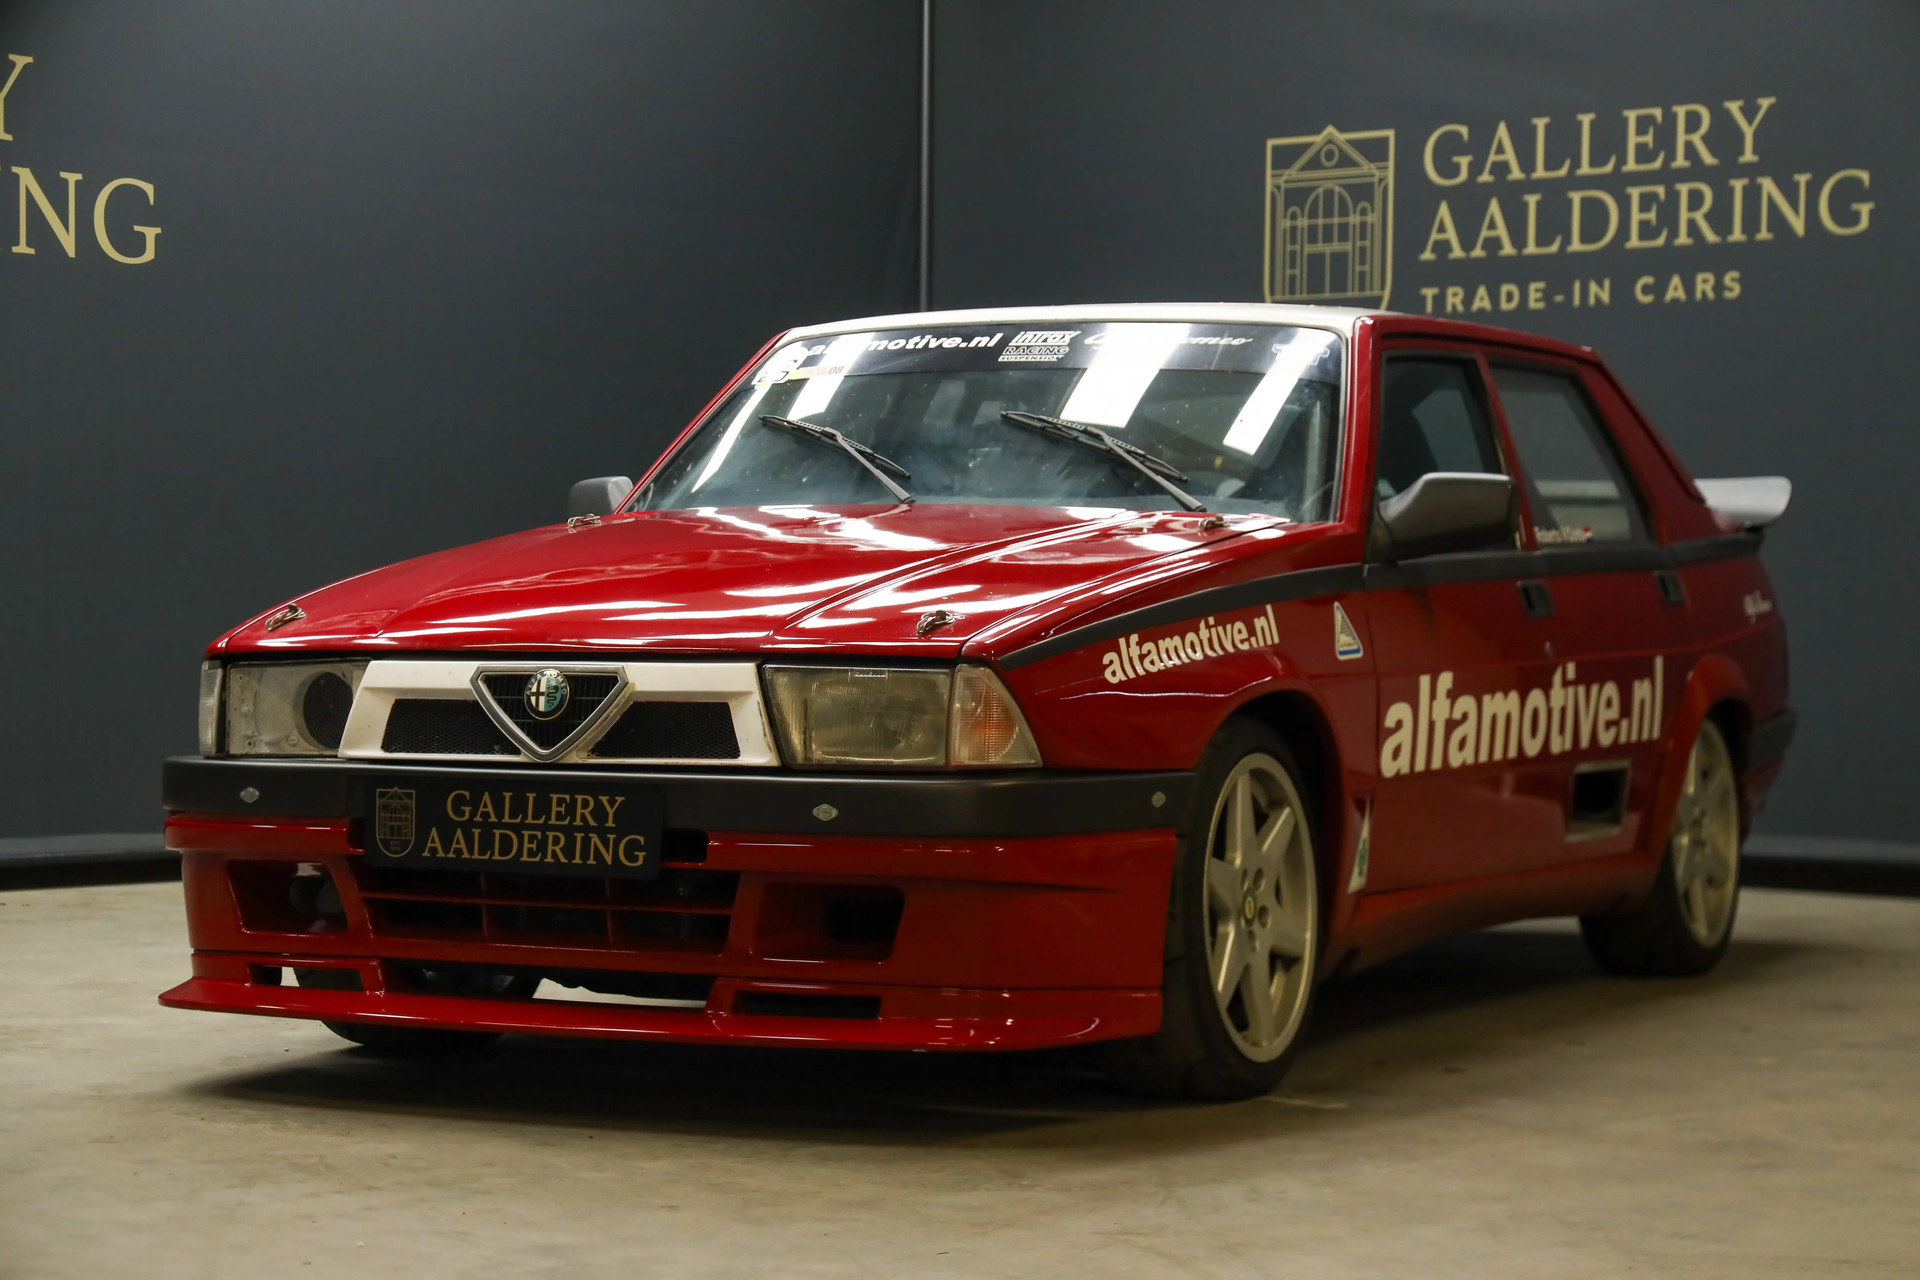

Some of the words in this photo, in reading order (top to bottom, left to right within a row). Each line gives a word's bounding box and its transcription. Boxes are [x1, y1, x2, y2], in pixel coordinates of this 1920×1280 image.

[1423, 97, 1777, 187] GALLERY
[0, 166, 162, 265] NG
[1419, 168, 1875, 261] AALDERING
[1421, 277, 1611, 314] TRADE-IN
[1635, 270, 1742, 304] CARS
[807, 332, 1004, 356] amotive.nl
[1002, 345, 1069, 355] RACING
[1102, 604, 1280, 684] alfamotive.nl
[1380, 655, 1664, 778] alfamotive.nl
[446, 790, 625, 827] GALLERY
[422, 827, 647, 867] AALDERING
